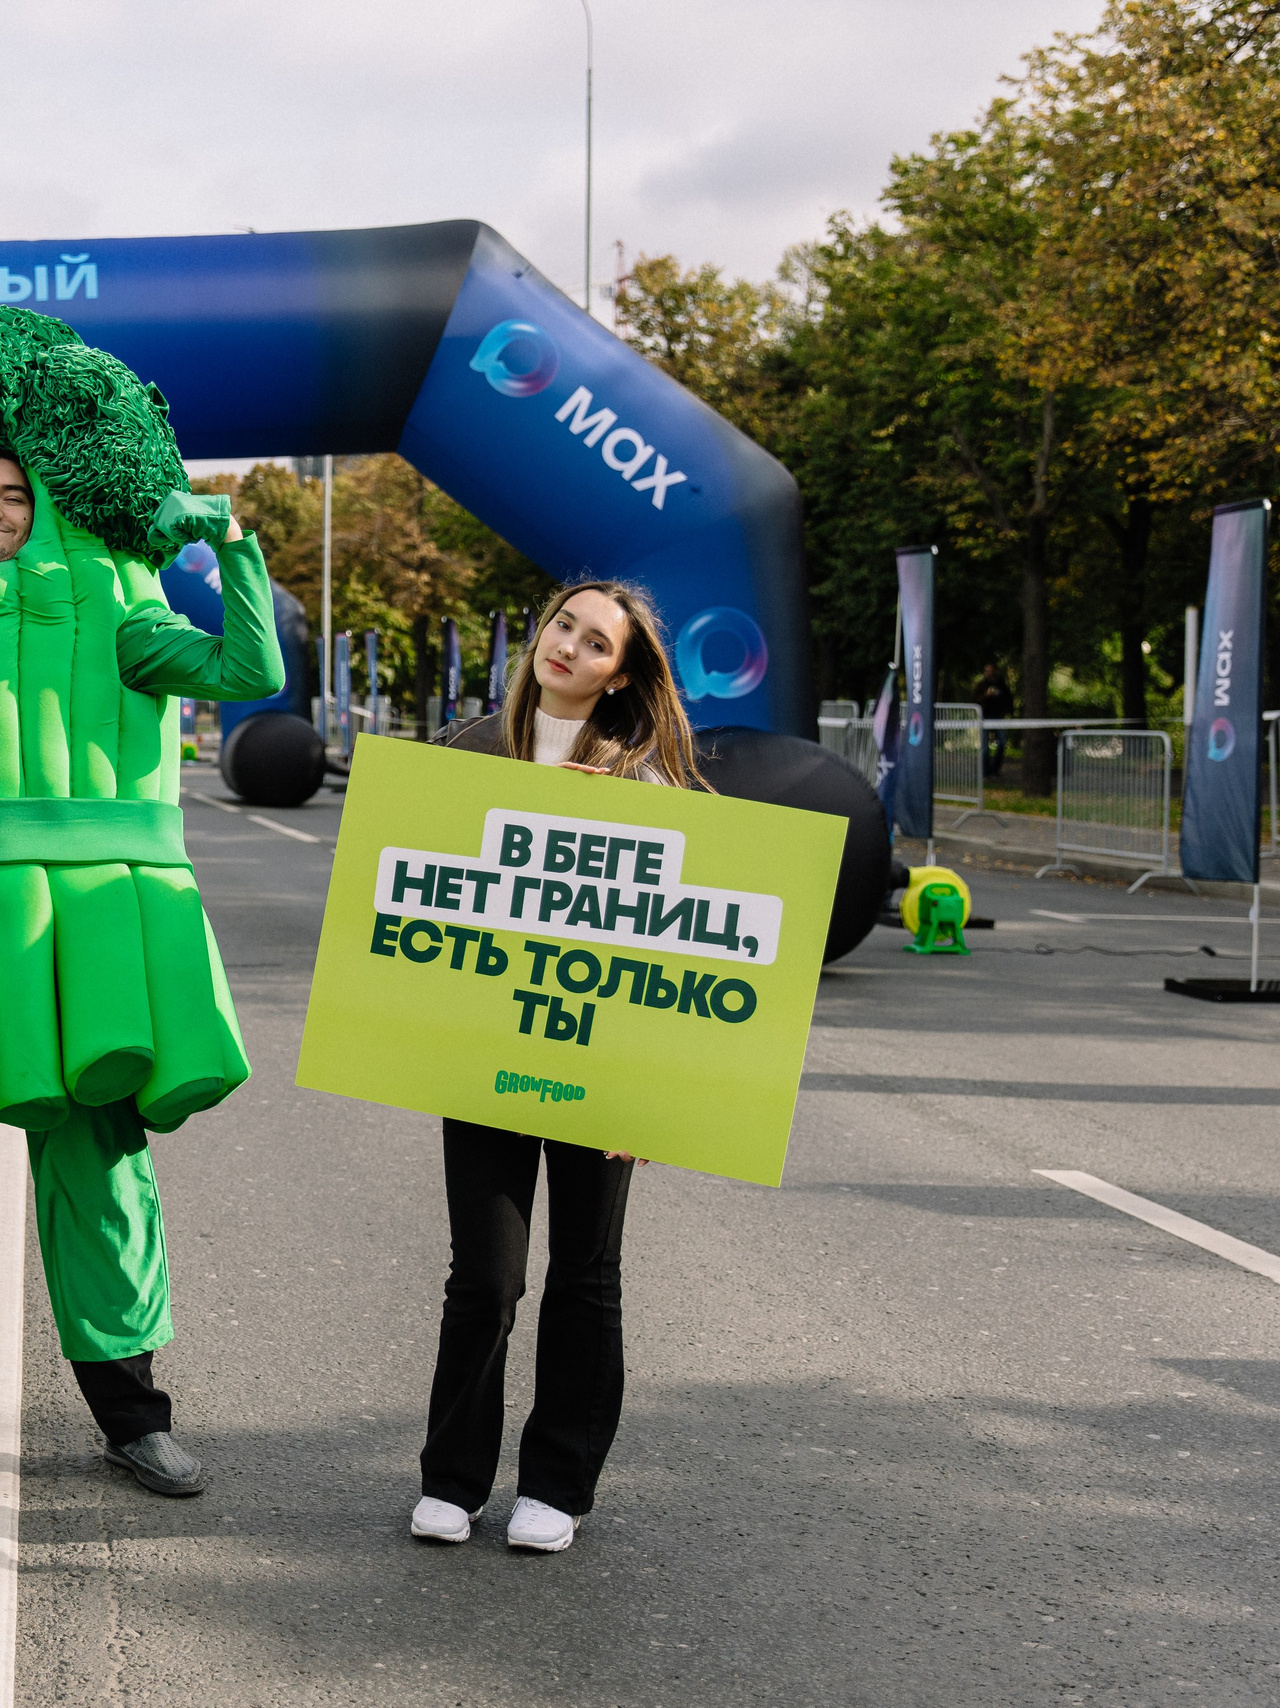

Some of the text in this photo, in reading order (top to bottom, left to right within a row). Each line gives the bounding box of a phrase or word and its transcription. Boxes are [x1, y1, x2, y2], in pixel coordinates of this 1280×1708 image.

[499, 823, 666, 886] В БЕГЕ
[391, 860, 760, 958] НЕТ ГРАНИЦ,
[369, 911, 758, 1024] ЕСТЬ ТОЛЬКО
[512, 988, 597, 1047] ТЫ
